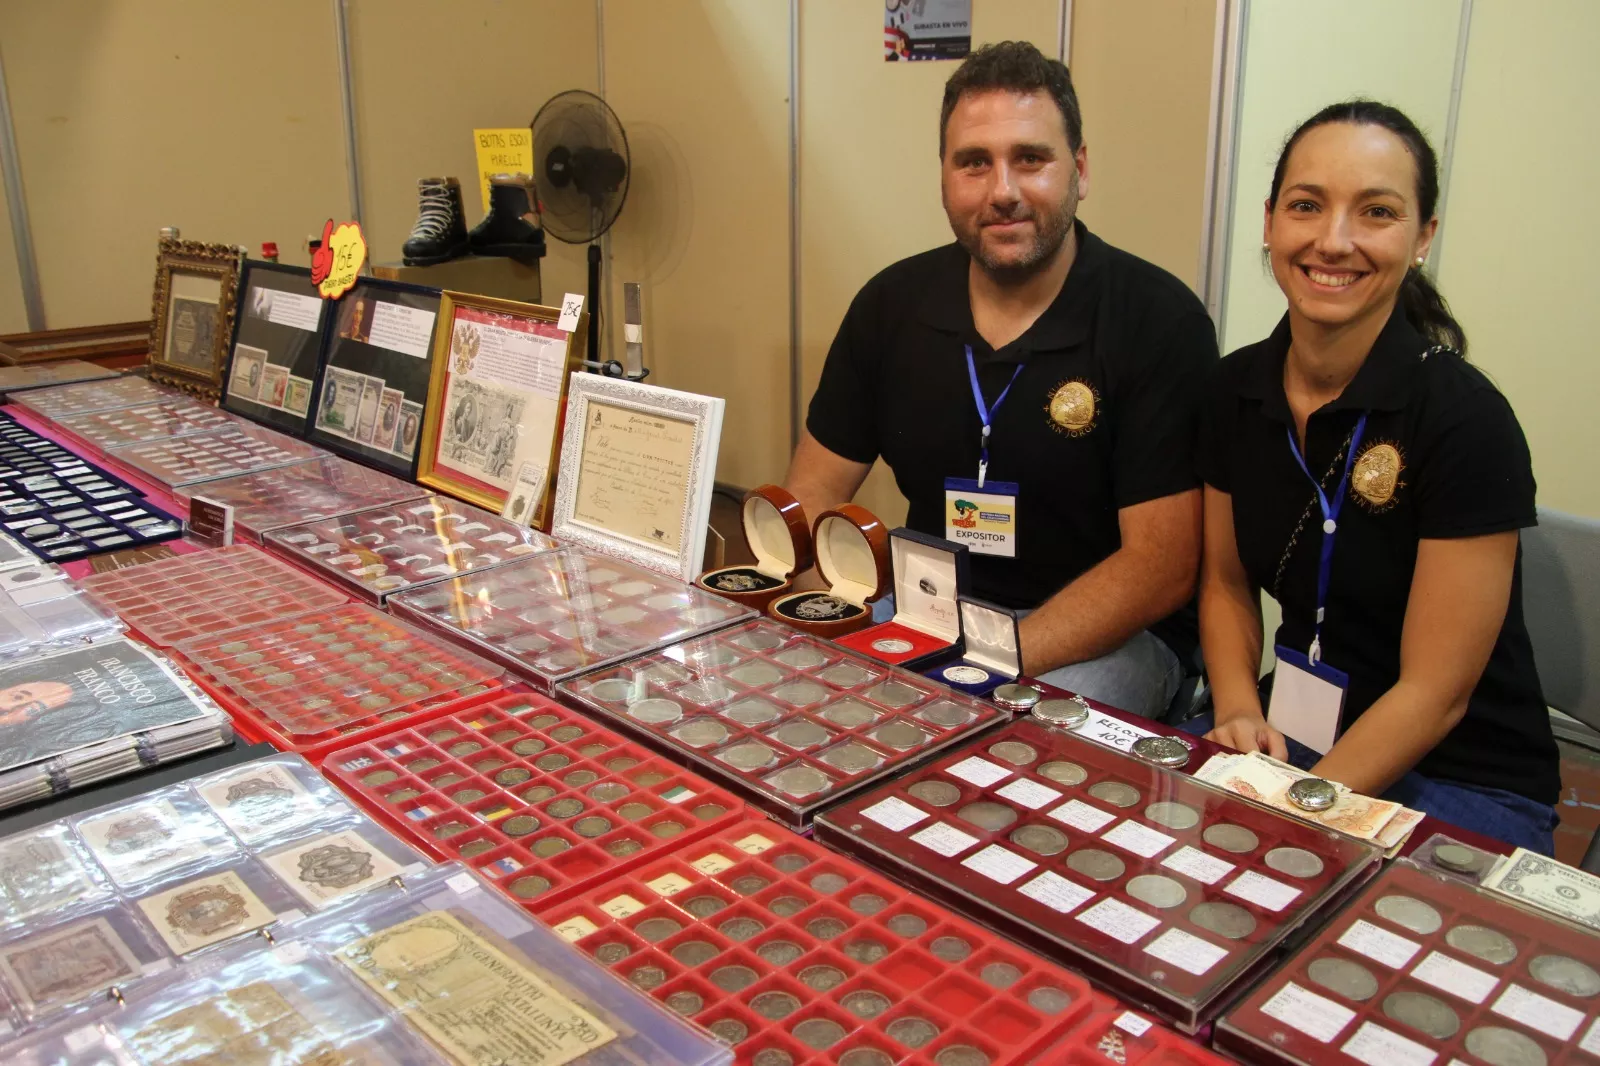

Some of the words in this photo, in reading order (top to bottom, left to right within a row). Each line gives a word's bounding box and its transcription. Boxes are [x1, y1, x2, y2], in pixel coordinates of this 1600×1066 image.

[913, 22, 941, 30] SUBASTA
[479, 134, 506, 148] BOTAS
[955, 530, 1006, 542] EXPOSITOR
[73, 667, 121, 704] FRANCO
[97, 656, 157, 704] FRANCISCO
[1097, 732, 1131, 746] 10€
[472, 950, 546, 1001] GENERALITAT
[502, 989, 569, 1040] CATALUNYA
